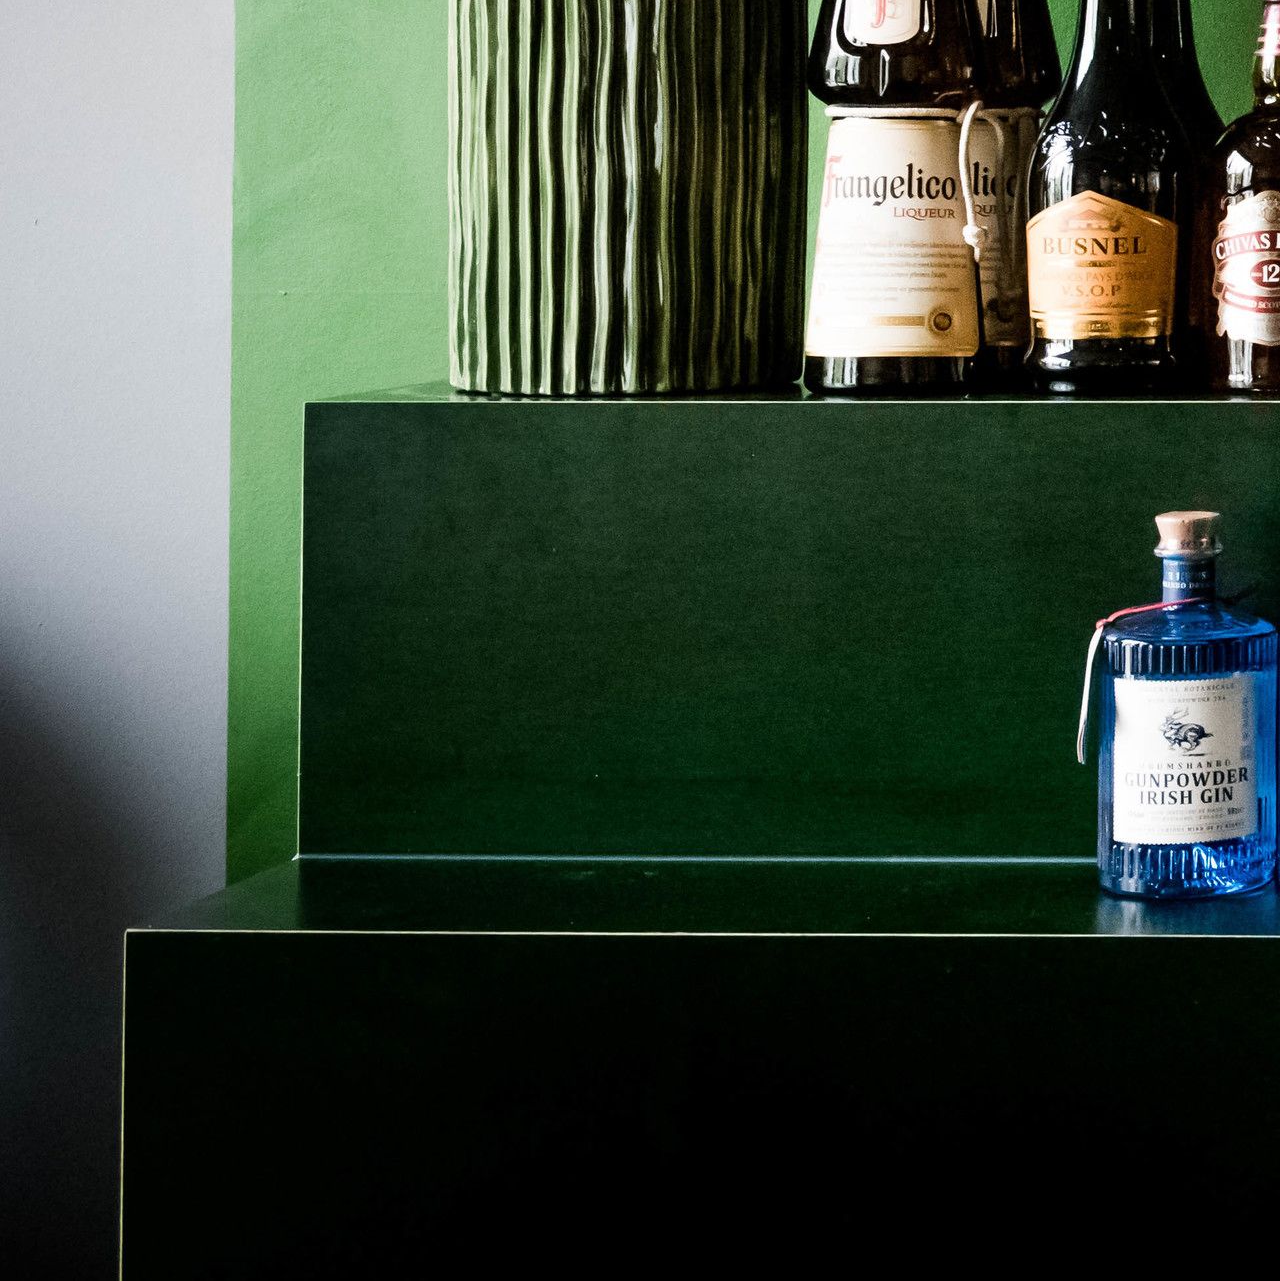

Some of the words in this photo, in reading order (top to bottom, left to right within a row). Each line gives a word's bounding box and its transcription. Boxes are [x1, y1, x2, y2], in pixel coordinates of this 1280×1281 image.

[893, 207, 956, 221] LIQUEUR
[1043, 235, 1147, 256] BUSNEL
[1215, 232, 1271, 261] CHIVAS
[1261, 263, 1280, 283] 12
[1142, 758, 1232, 770] UMSHANBO
[1125, 767, 1250, 789] GUNPOWDER
[1140, 790, 1193, 805] IRISH
[1200, 786, 1234, 804] GIN
